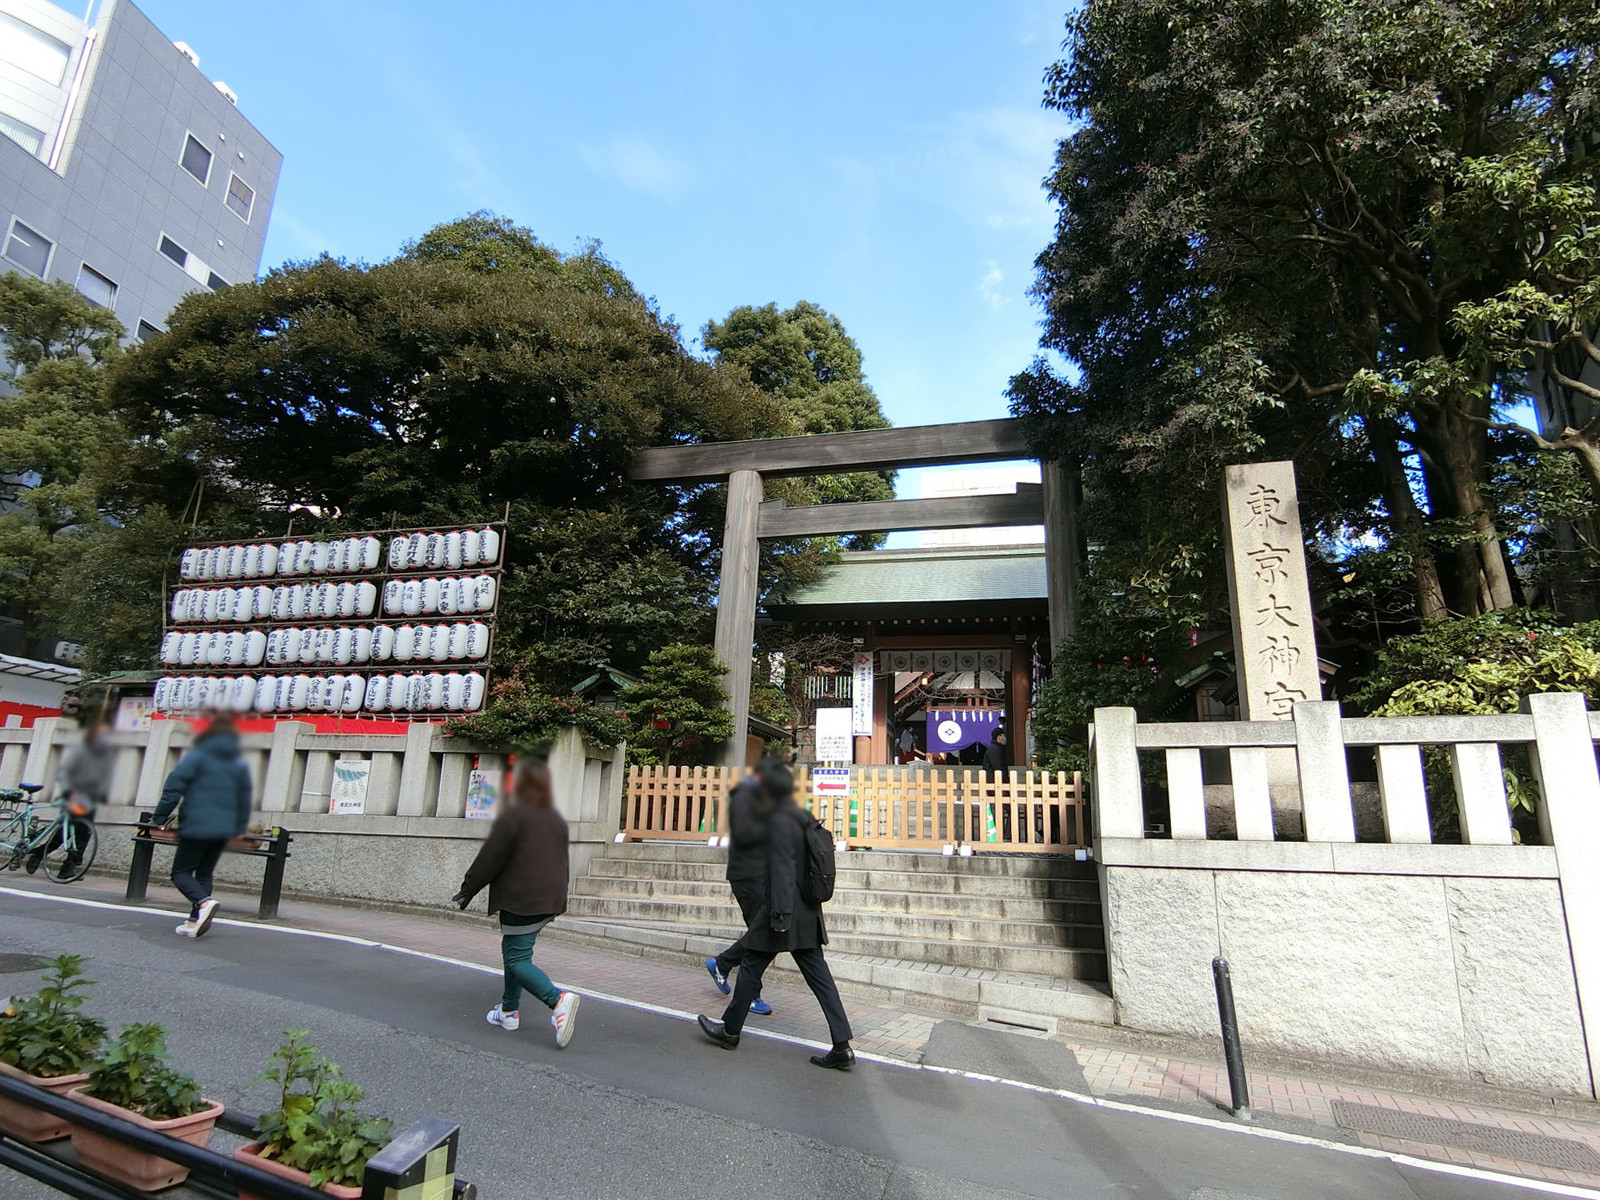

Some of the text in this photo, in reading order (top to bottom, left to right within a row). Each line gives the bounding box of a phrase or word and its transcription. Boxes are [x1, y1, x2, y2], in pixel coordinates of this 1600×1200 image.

[440, 582, 449, 612] はま家
[1243, 484, 1307, 721] 東京大神宮
